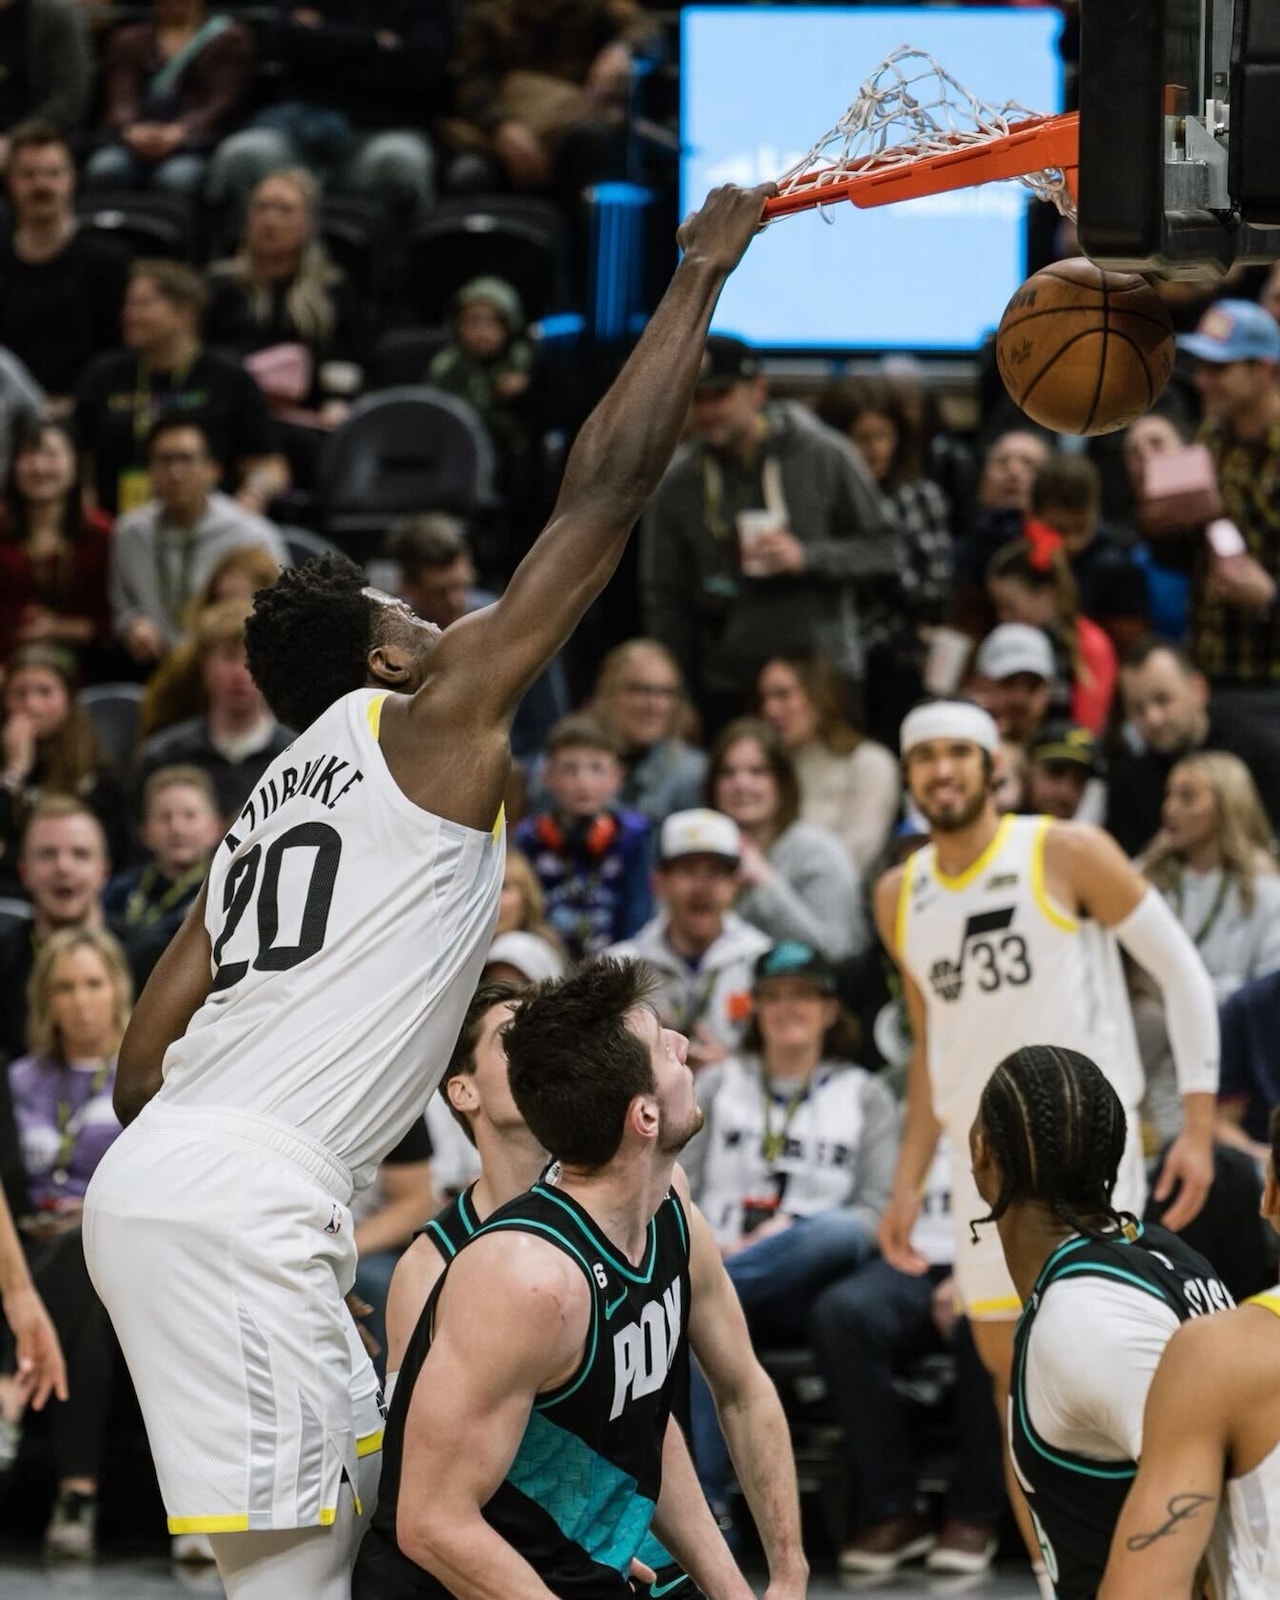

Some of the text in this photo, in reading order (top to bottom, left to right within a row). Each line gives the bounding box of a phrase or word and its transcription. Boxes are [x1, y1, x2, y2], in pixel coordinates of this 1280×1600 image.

[207, 821, 343, 995] 20
[971, 934, 1032, 993] 33
[592, 1262, 609, 1290] 6
